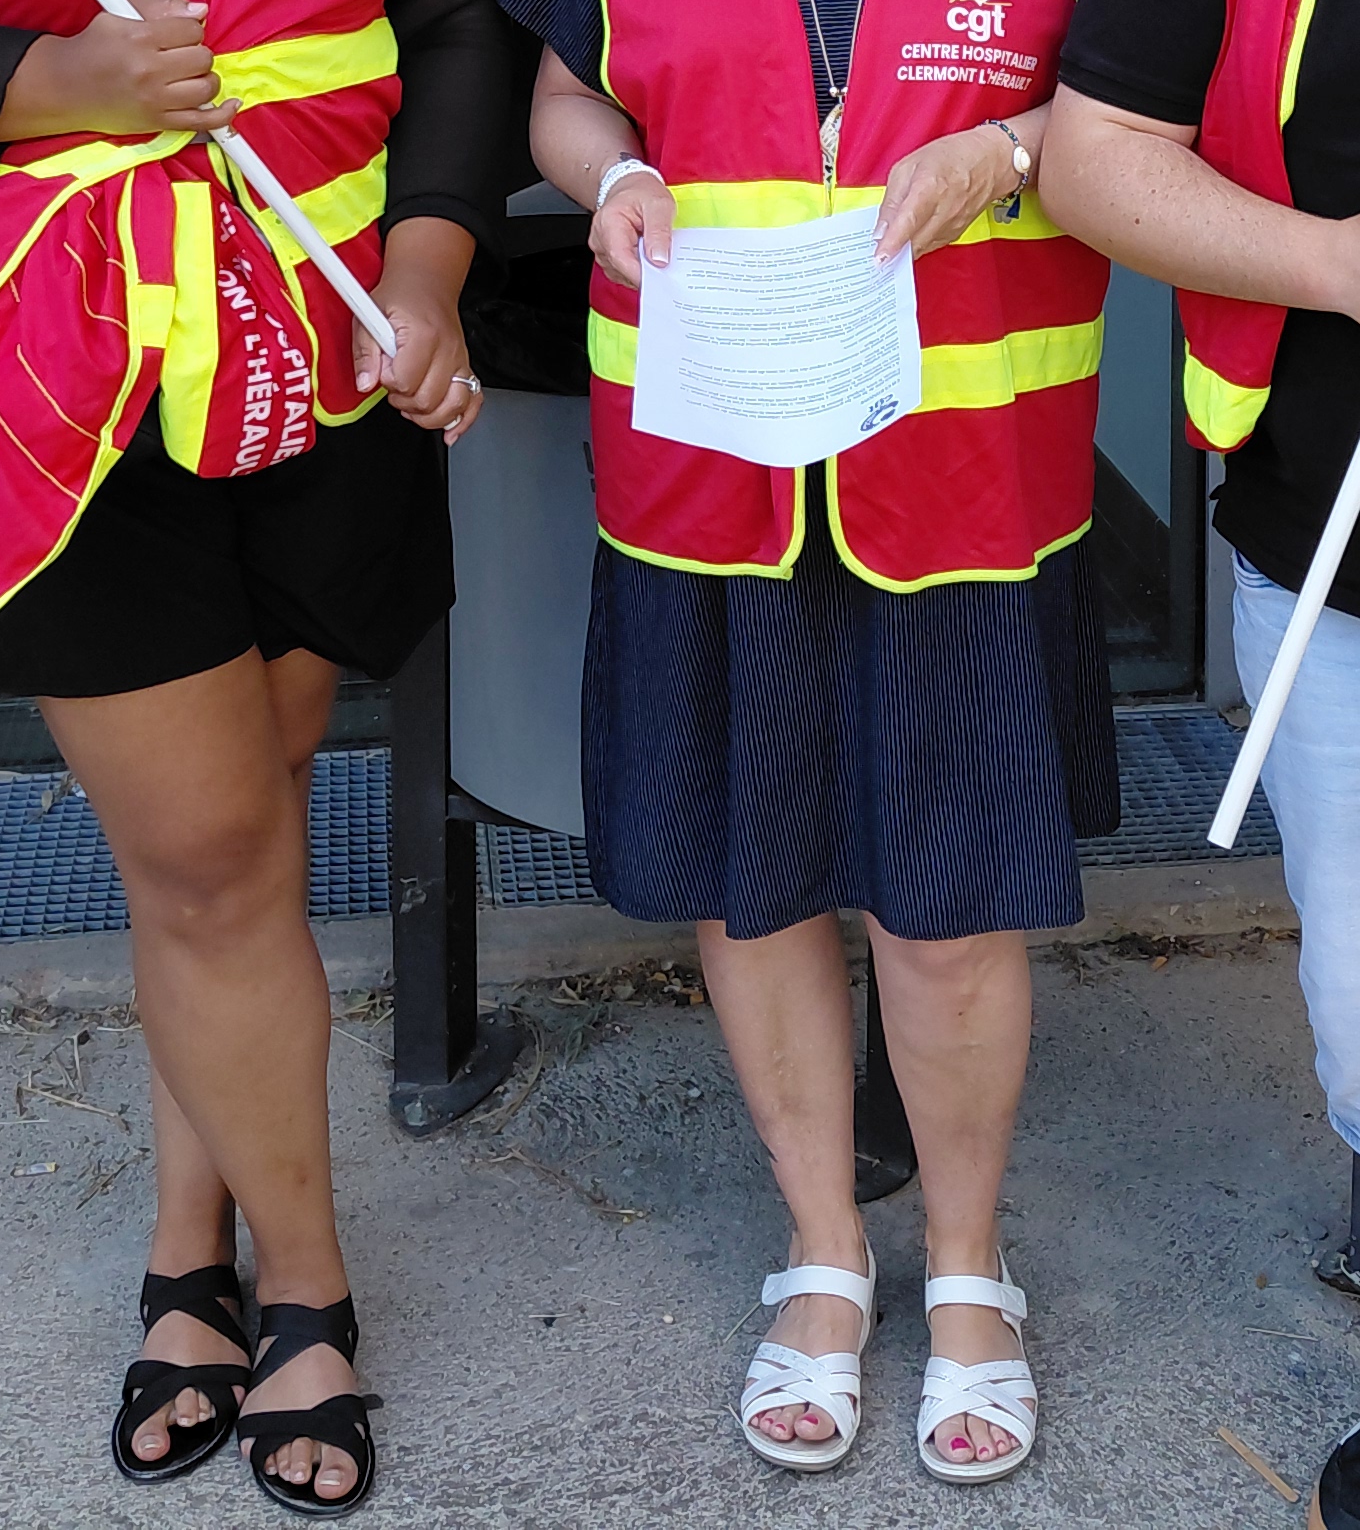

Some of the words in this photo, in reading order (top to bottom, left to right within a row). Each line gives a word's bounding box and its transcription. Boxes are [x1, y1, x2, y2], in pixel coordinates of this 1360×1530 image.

[946, 4, 1006, 42] cgt
[901, 43, 960, 60] CENTRE
[961, 44, 1038, 72] HOSPITALIER
[897, 65, 978, 83] CLERMONT
[978, 67, 1033, 91] L'HÉRAULT
